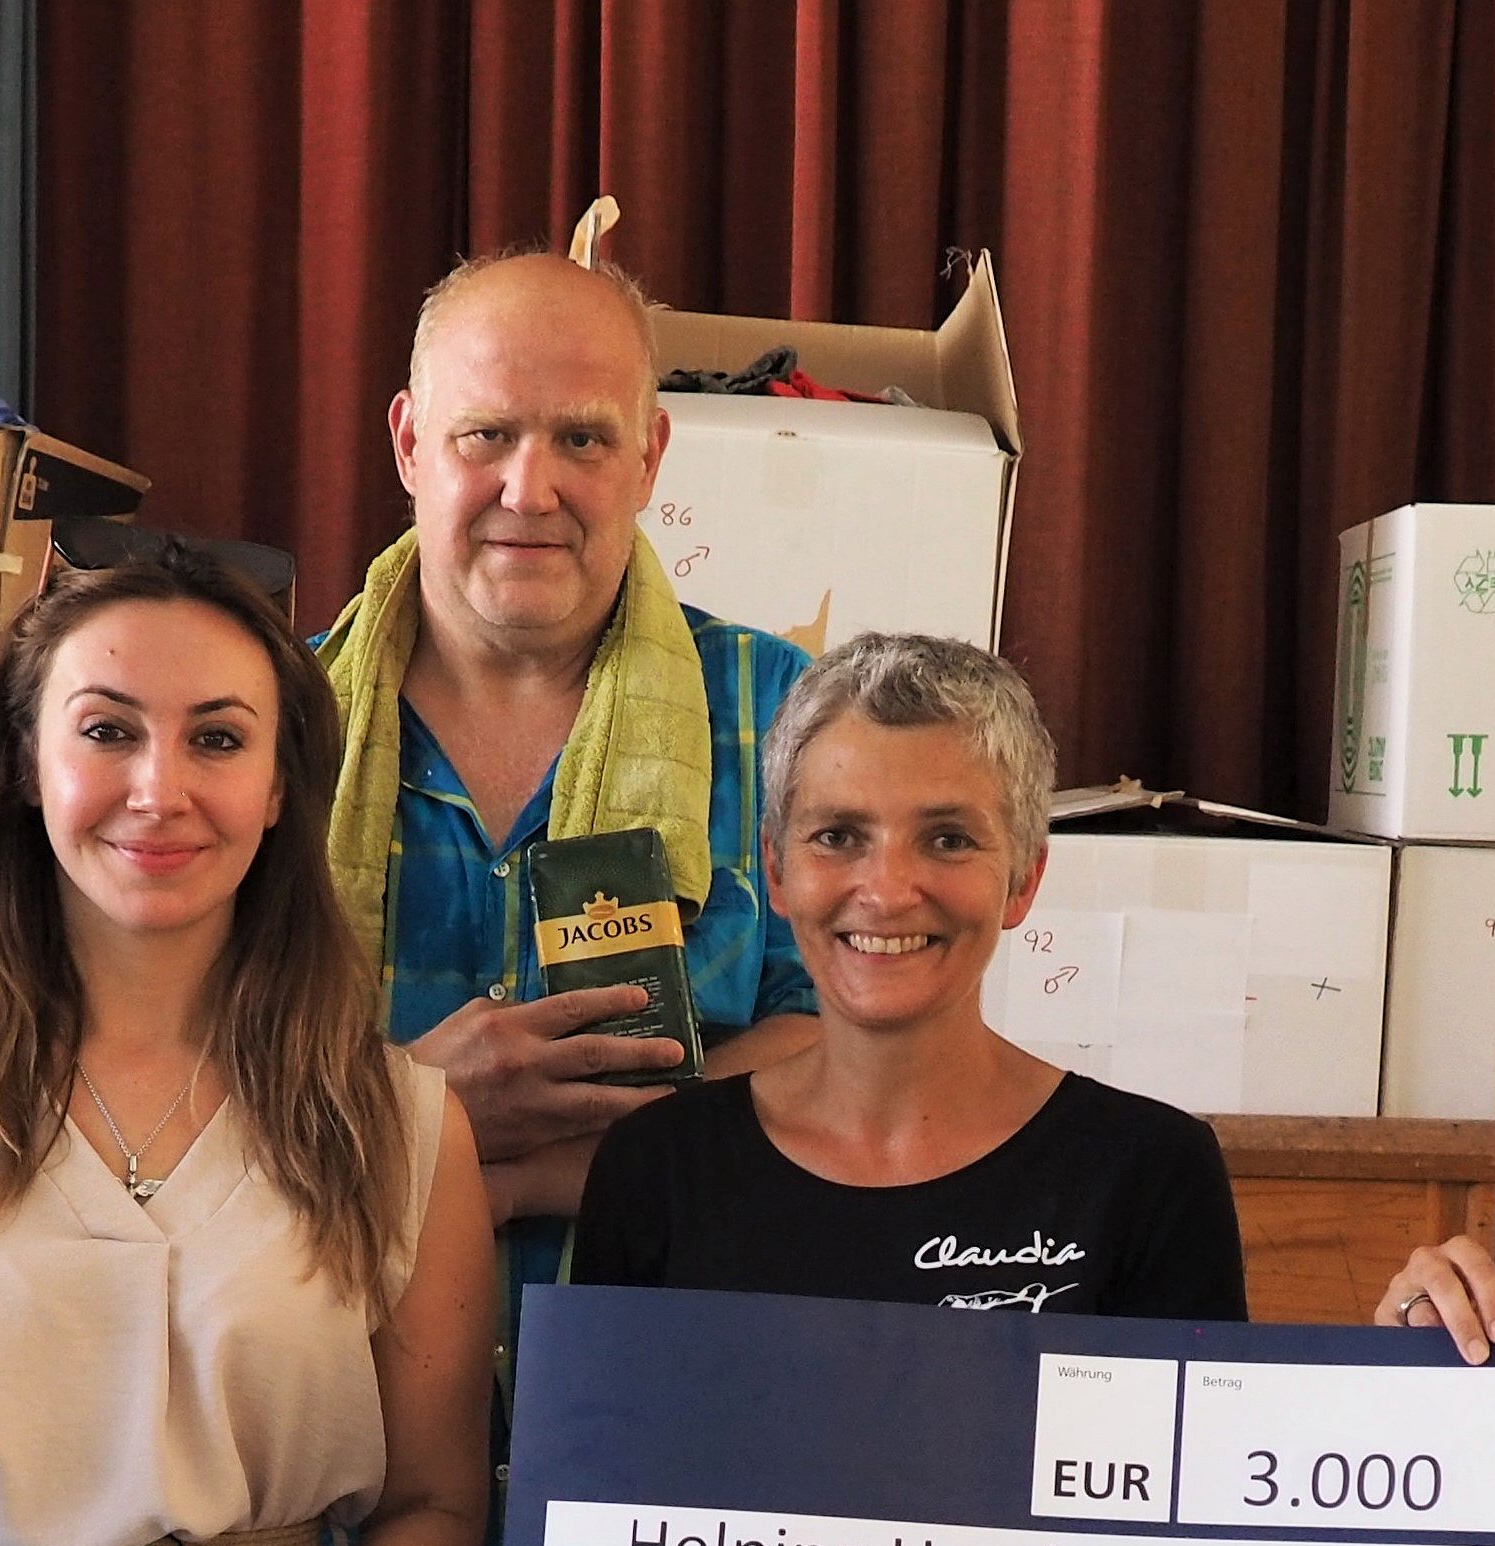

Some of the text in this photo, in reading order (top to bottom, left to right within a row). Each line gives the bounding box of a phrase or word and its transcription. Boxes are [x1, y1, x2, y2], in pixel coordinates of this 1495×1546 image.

[660, 502, 693, 526] 86
[557, 913, 653, 950] JACOBS
[1023, 929, 1053, 953] 92
[913, 1229, 1086, 1270] Claudia
[1057, 1365, 1113, 1382] Währung
[1201, 1375, 1243, 1391] Betrag
[1052, 1449, 1443, 1512] EUR 3.000
